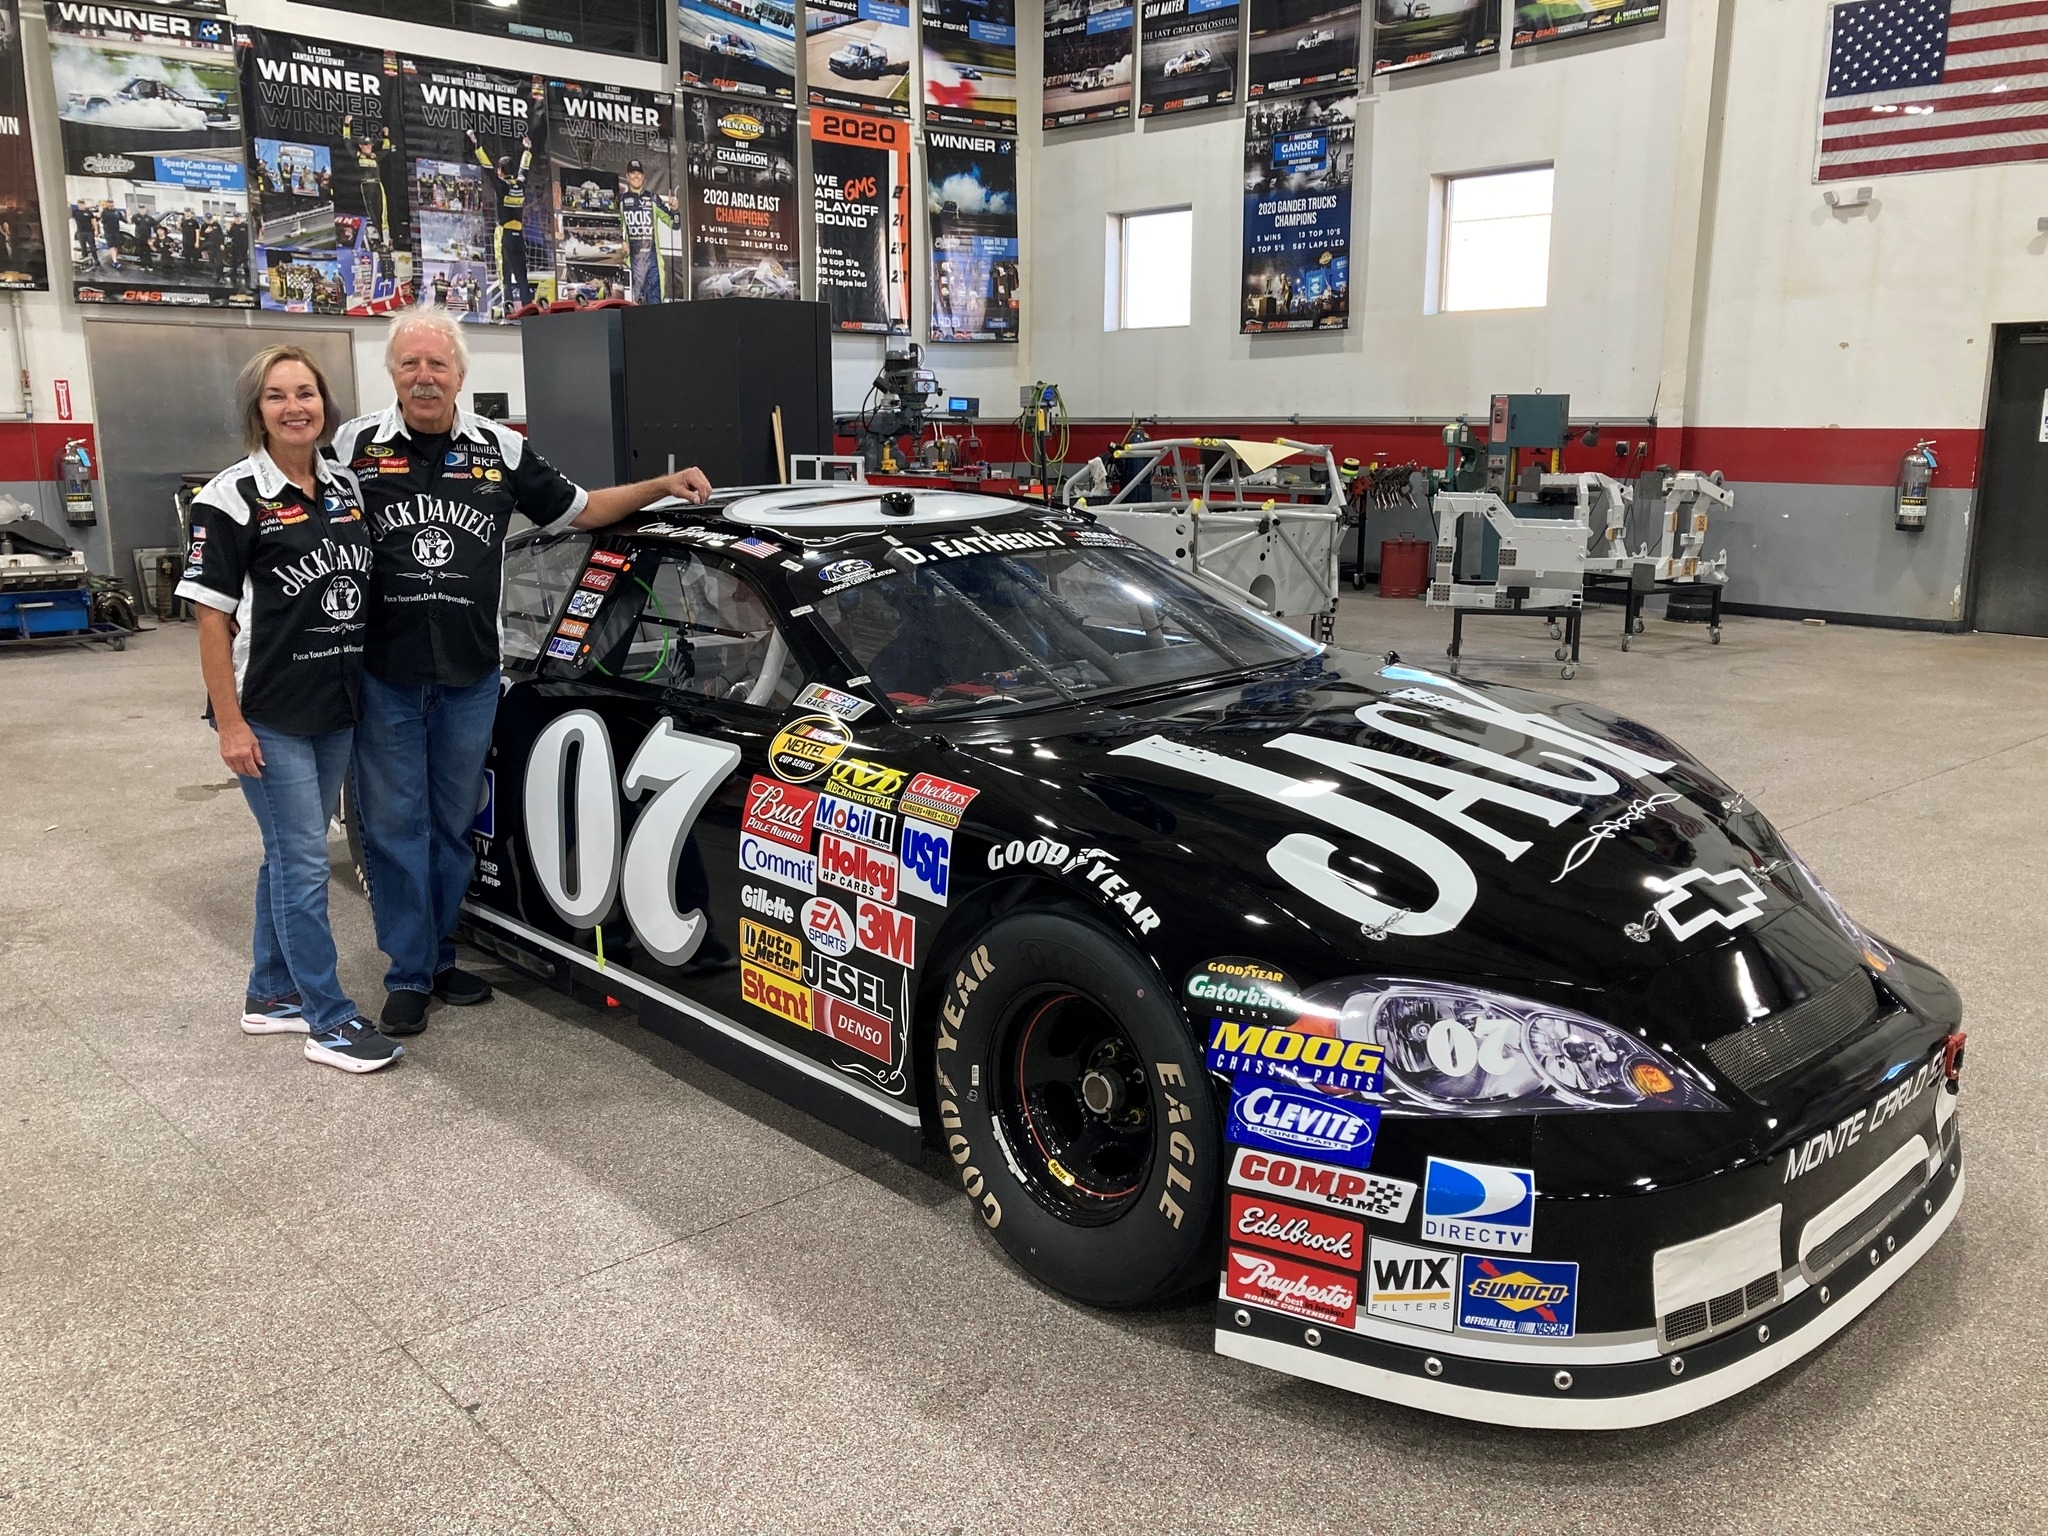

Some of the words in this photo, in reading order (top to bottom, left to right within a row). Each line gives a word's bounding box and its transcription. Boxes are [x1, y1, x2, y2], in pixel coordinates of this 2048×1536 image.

[58, 2, 191, 38] WINNER
[1145, 4, 1160, 19] SAM
[1160, 0, 1185, 15] MAYER
[1154, 29, 1171, 38] LAST
[1173, 25, 1193, 36] GREAT
[1195, 18, 1238, 32] COLOSSEUM
[1536, 26, 1558, 38] GMS
[292, 52, 314, 63] KANSAS
[316, 55, 346, 68] SPEEDWAY
[256, 57, 381, 96] WINNER
[432, 74, 450, 84] WORLD
[450, 76, 464, 86] WIDE
[465, 79, 494, 91] TECHNOLOGY
[494, 84, 518, 95] RACEWAY
[258, 81, 382, 119] WINNER
[420, 83, 528, 118] WINNER
[563, 97, 660, 126] WINNER
[1164, 98, 1185, 110] GMS
[422, 106, 529, 139] WINNER
[564, 118, 661, 147] WINNER
[718, 119, 765, 134] MENARDS
[822, 116, 896, 144] 2020
[735, 140, 750, 149] EAST
[930, 132, 996, 153] WINNER
[1281, 139, 1319, 154] GANDER
[162, 158, 224, 172] SpeedyCash.com
[224, 164, 238, 172] 400
[717, 150, 768, 166] CHAMPION
[203, 172, 231, 181] Speedway
[814, 174, 838, 187] WE
[844, 176, 877, 200] GMS
[704, 188, 729, 206] 2020
[731, 192, 756, 209] ARCA
[758, 194, 780, 212] EAST
[814, 186, 844, 200] ARE
[716, 206, 770, 227] CHAMPIONS
[815, 200, 879, 216] PLAYOFF
[1258, 202, 1276, 216] 2020
[1278, 198, 1306, 214] GANDER
[1308, 194, 1337, 210] TRUCKS
[624, 210, 652, 226] FOCUS
[701, 224, 706, 232] 5
[709, 226, 728, 234] WINS
[816, 212, 868, 228] BOUND
[1274, 212, 1318, 228] CHAMPIONS
[704, 236, 728, 245] POLES
[1264, 233, 1282, 242] WINS
[1298, 230, 1306, 238] 13
[1308, 229, 1324, 238] TOP
[1326, 228, 1341, 236] 10'S
[1308, 240, 1328, 249] LAPS
[1331, 238, 1344, 247] LED
[754, 241, 773, 250] LAPS
[776, 242, 789, 252] LED
[822, 248, 842, 256] wins
[1258, 245, 1272, 253] TOP
[1274, 244, 1285, 252] 5'S
[829, 258, 844, 268] top
[846, 258, 860, 268] 5's
[829, 268, 845, 278] top
[846, 268, 866, 278] 10's
[836, 278, 854, 288] laps
[854, 279, 868, 288] led
[123, 290, 162, 302] GMS
[841, 322, 862, 330] GMS
[1268, 320, 1289, 330] GMS
[373, 502, 417, 542] JACK
[415, 493, 497, 544] DANIEL'S
[592, 550, 625, 566] Snap-on
[895, 546, 938, 566] D.
[930, 530, 1067, 559] EATHERLY
[272, 547, 333, 597] JACK
[826, 560, 871, 582] AGS
[850, 568, 897, 585] CERTIFICATION
[560, 622, 586, 636] Autolite
[292, 652, 309, 661] Pace
[804, 698, 828, 710] RACE
[830, 703, 852, 716] CAR
[824, 692, 859, 710] NASCAR
[778, 754, 792, 764] CUP
[791, 758, 816, 771] SERIES
[824, 778, 868, 806] MECHANIX
[866, 793, 894, 810] WEAR
[912, 778, 968, 805] Checkers
[750, 782, 814, 825] Bud
[902, 802, 922, 815] BURGERS
[925, 808, 940, 820] FRIES
[940, 812, 956, 824] COLAS
[1107, 682, 1678, 936] JACK
[816, 796, 872, 838] Mobil
[880, 816, 887, 840] 1
[523, 708, 742, 967] 07
[746, 817, 769, 834] POLE
[770, 822, 804, 844] AWARD
[815, 822, 834, 832] OFFICIAL
[834, 828, 850, 836] MOTOR
[860, 836, 890, 850] LUBRICANTS
[480, 860, 498, 872] MSD
[742, 838, 814, 886] Commit
[822, 836, 896, 902] Holley
[902, 828, 949, 897] USG
[481, 874, 501, 888] ARP
[822, 870, 836, 882] HP
[840, 874, 876, 896] CARBS
[988, 839, 1161, 935] GOODYEAR
[741, 884, 795, 924] Gillette
[809, 900, 846, 939] EA
[758, 929, 793, 955] Auto
[808, 928, 847, 953] SPORTS
[858, 902, 914, 966] 3M
[756, 942, 799, 972] Meter
[1207, 962, 1284, 982] GOODYEAR
[743, 968, 809, 1024] Stant
[802, 950, 894, 1022] JESEL
[1215, 1004, 1269, 1018] BELTS
[838, 1014, 882, 1046] DENSO
[1211, 1021, 1384, 1074] MOOG
[1426, 1016, 1517, 1078] 07
[1216, 1053, 1299, 1080] CHASSIS
[1314, 1069, 1375, 1092] PARTS
[936, 944, 1003, 1229] GOODYEAR
[1242, 1087, 1365, 1144] CLEVITE
[1784, 1108, 1867, 1184] MONTE
[1868, 1064, 1929, 1133] CARLO
[1156, 1062, 1196, 1230] EAGLE
[1250, 1126, 1299, 1141] ENGINE
[1306, 1136, 1350, 1150] PARTS
[1239, 1154, 1367, 1198] COMP
[1326, 1192, 1391, 1216] CAMS
[1238, 1206, 1353, 1259] Edelbrock
[1426, 1220, 1524, 1246] DIRECTV
[1232, 1252, 1354, 1310] Raybestos
[1373, 1256, 1452, 1291] WIX
[1260, 1288, 1277, 1300] The
[1284, 1294, 1305, 1308] best
[1304, 1300, 1314, 1310] in
[1314, 1302, 1345, 1318] brakes
[1472, 1280, 1566, 1303] SUNOCO
[1244, 1292, 1279, 1308] ROOKIE
[1280, 1302, 1338, 1323] CONTENDER
[1371, 1302, 1451, 1315] FILTERS
[1464, 1315, 1500, 1326] OFFICIAL
[1500, 1320, 1516, 1329] FUEL
[1534, 1322, 1570, 1336] NASCAR
